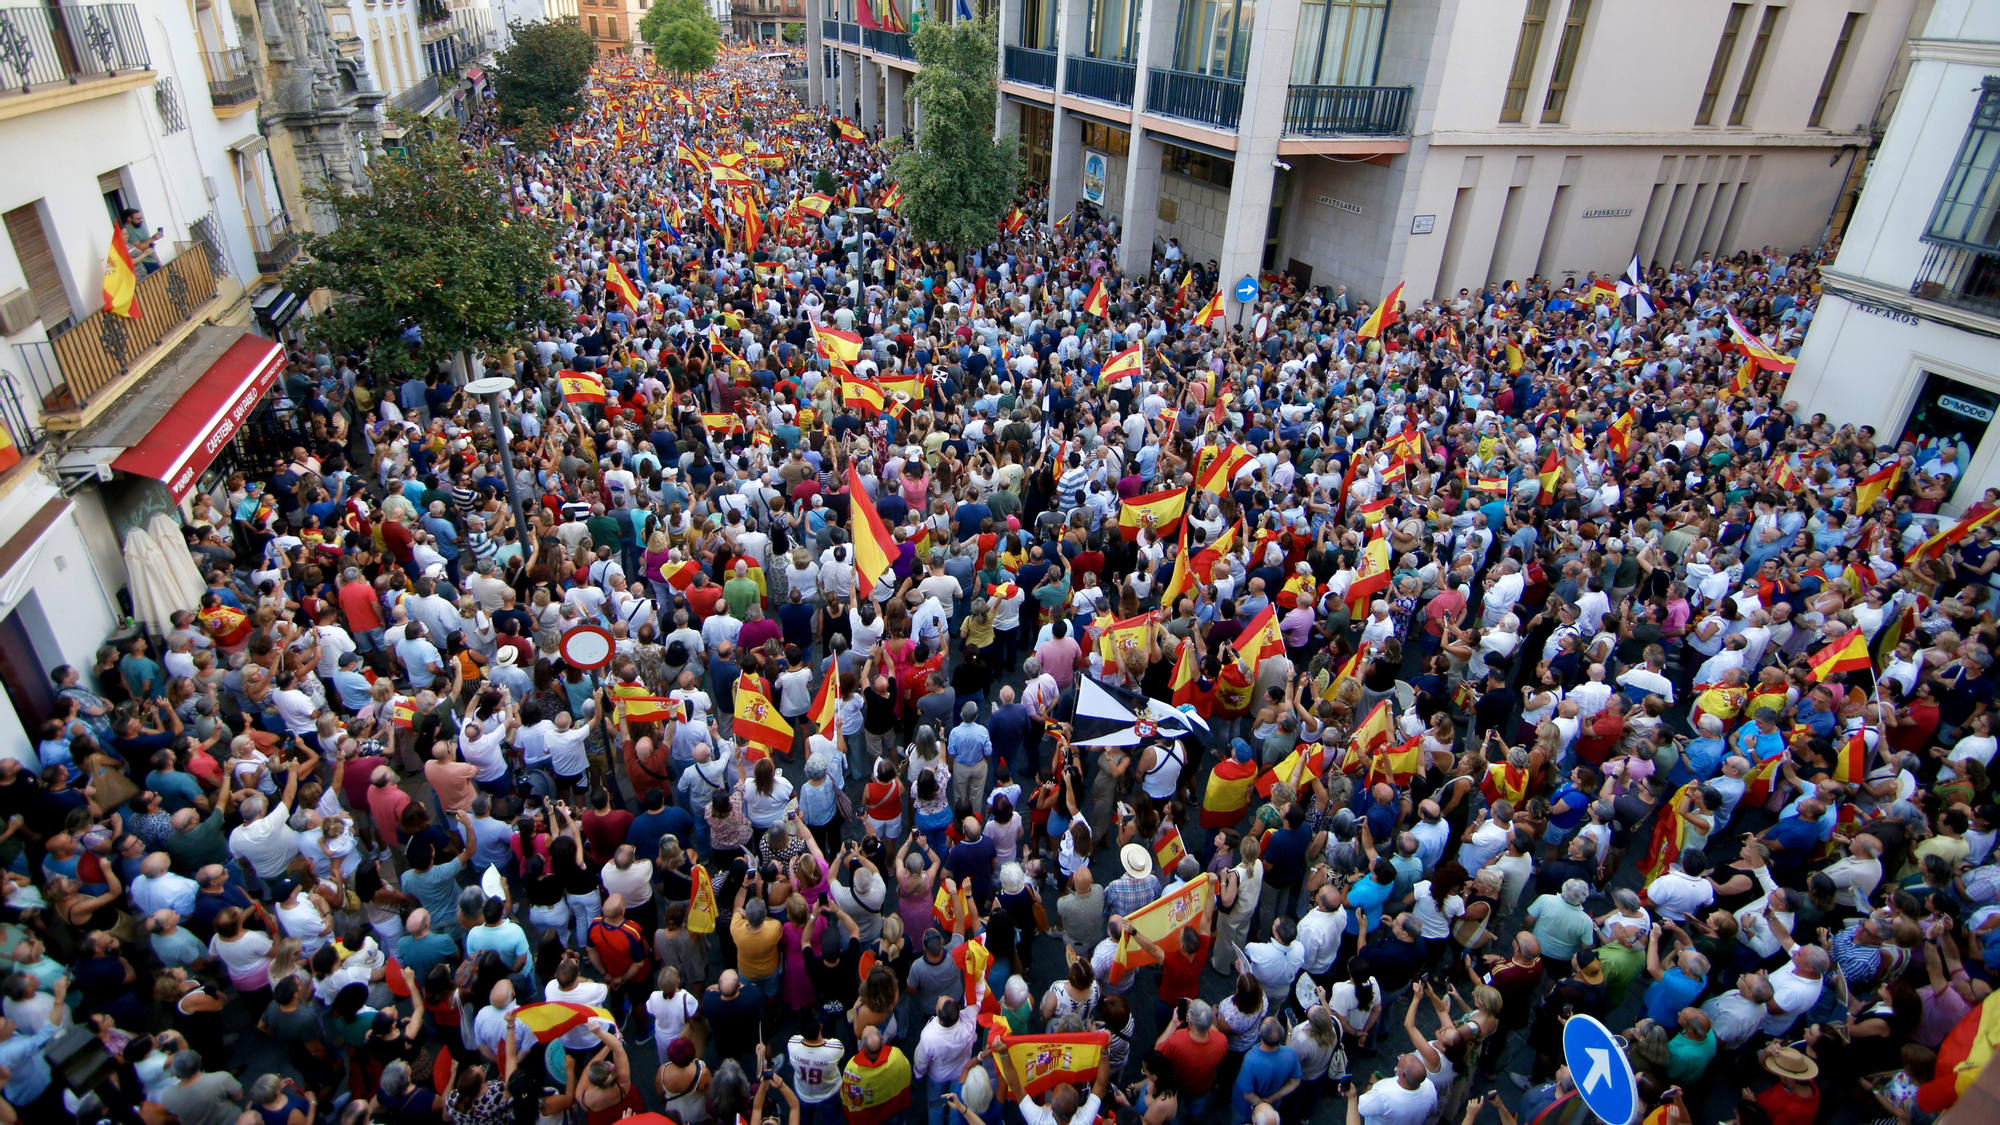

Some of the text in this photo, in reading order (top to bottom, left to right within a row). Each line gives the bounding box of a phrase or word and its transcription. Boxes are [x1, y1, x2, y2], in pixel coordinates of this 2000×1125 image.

[1317, 195, 1361, 213] CAPITULARES
[1857, 303, 1919, 326] ALFAROS
[207, 387, 258, 454] CAFETERÍA SAN PABLO
[178, 466, 195, 492] AMBAR
[795, 1055, 811, 1065] LAMINE
[799, 1065, 823, 1085] 19
